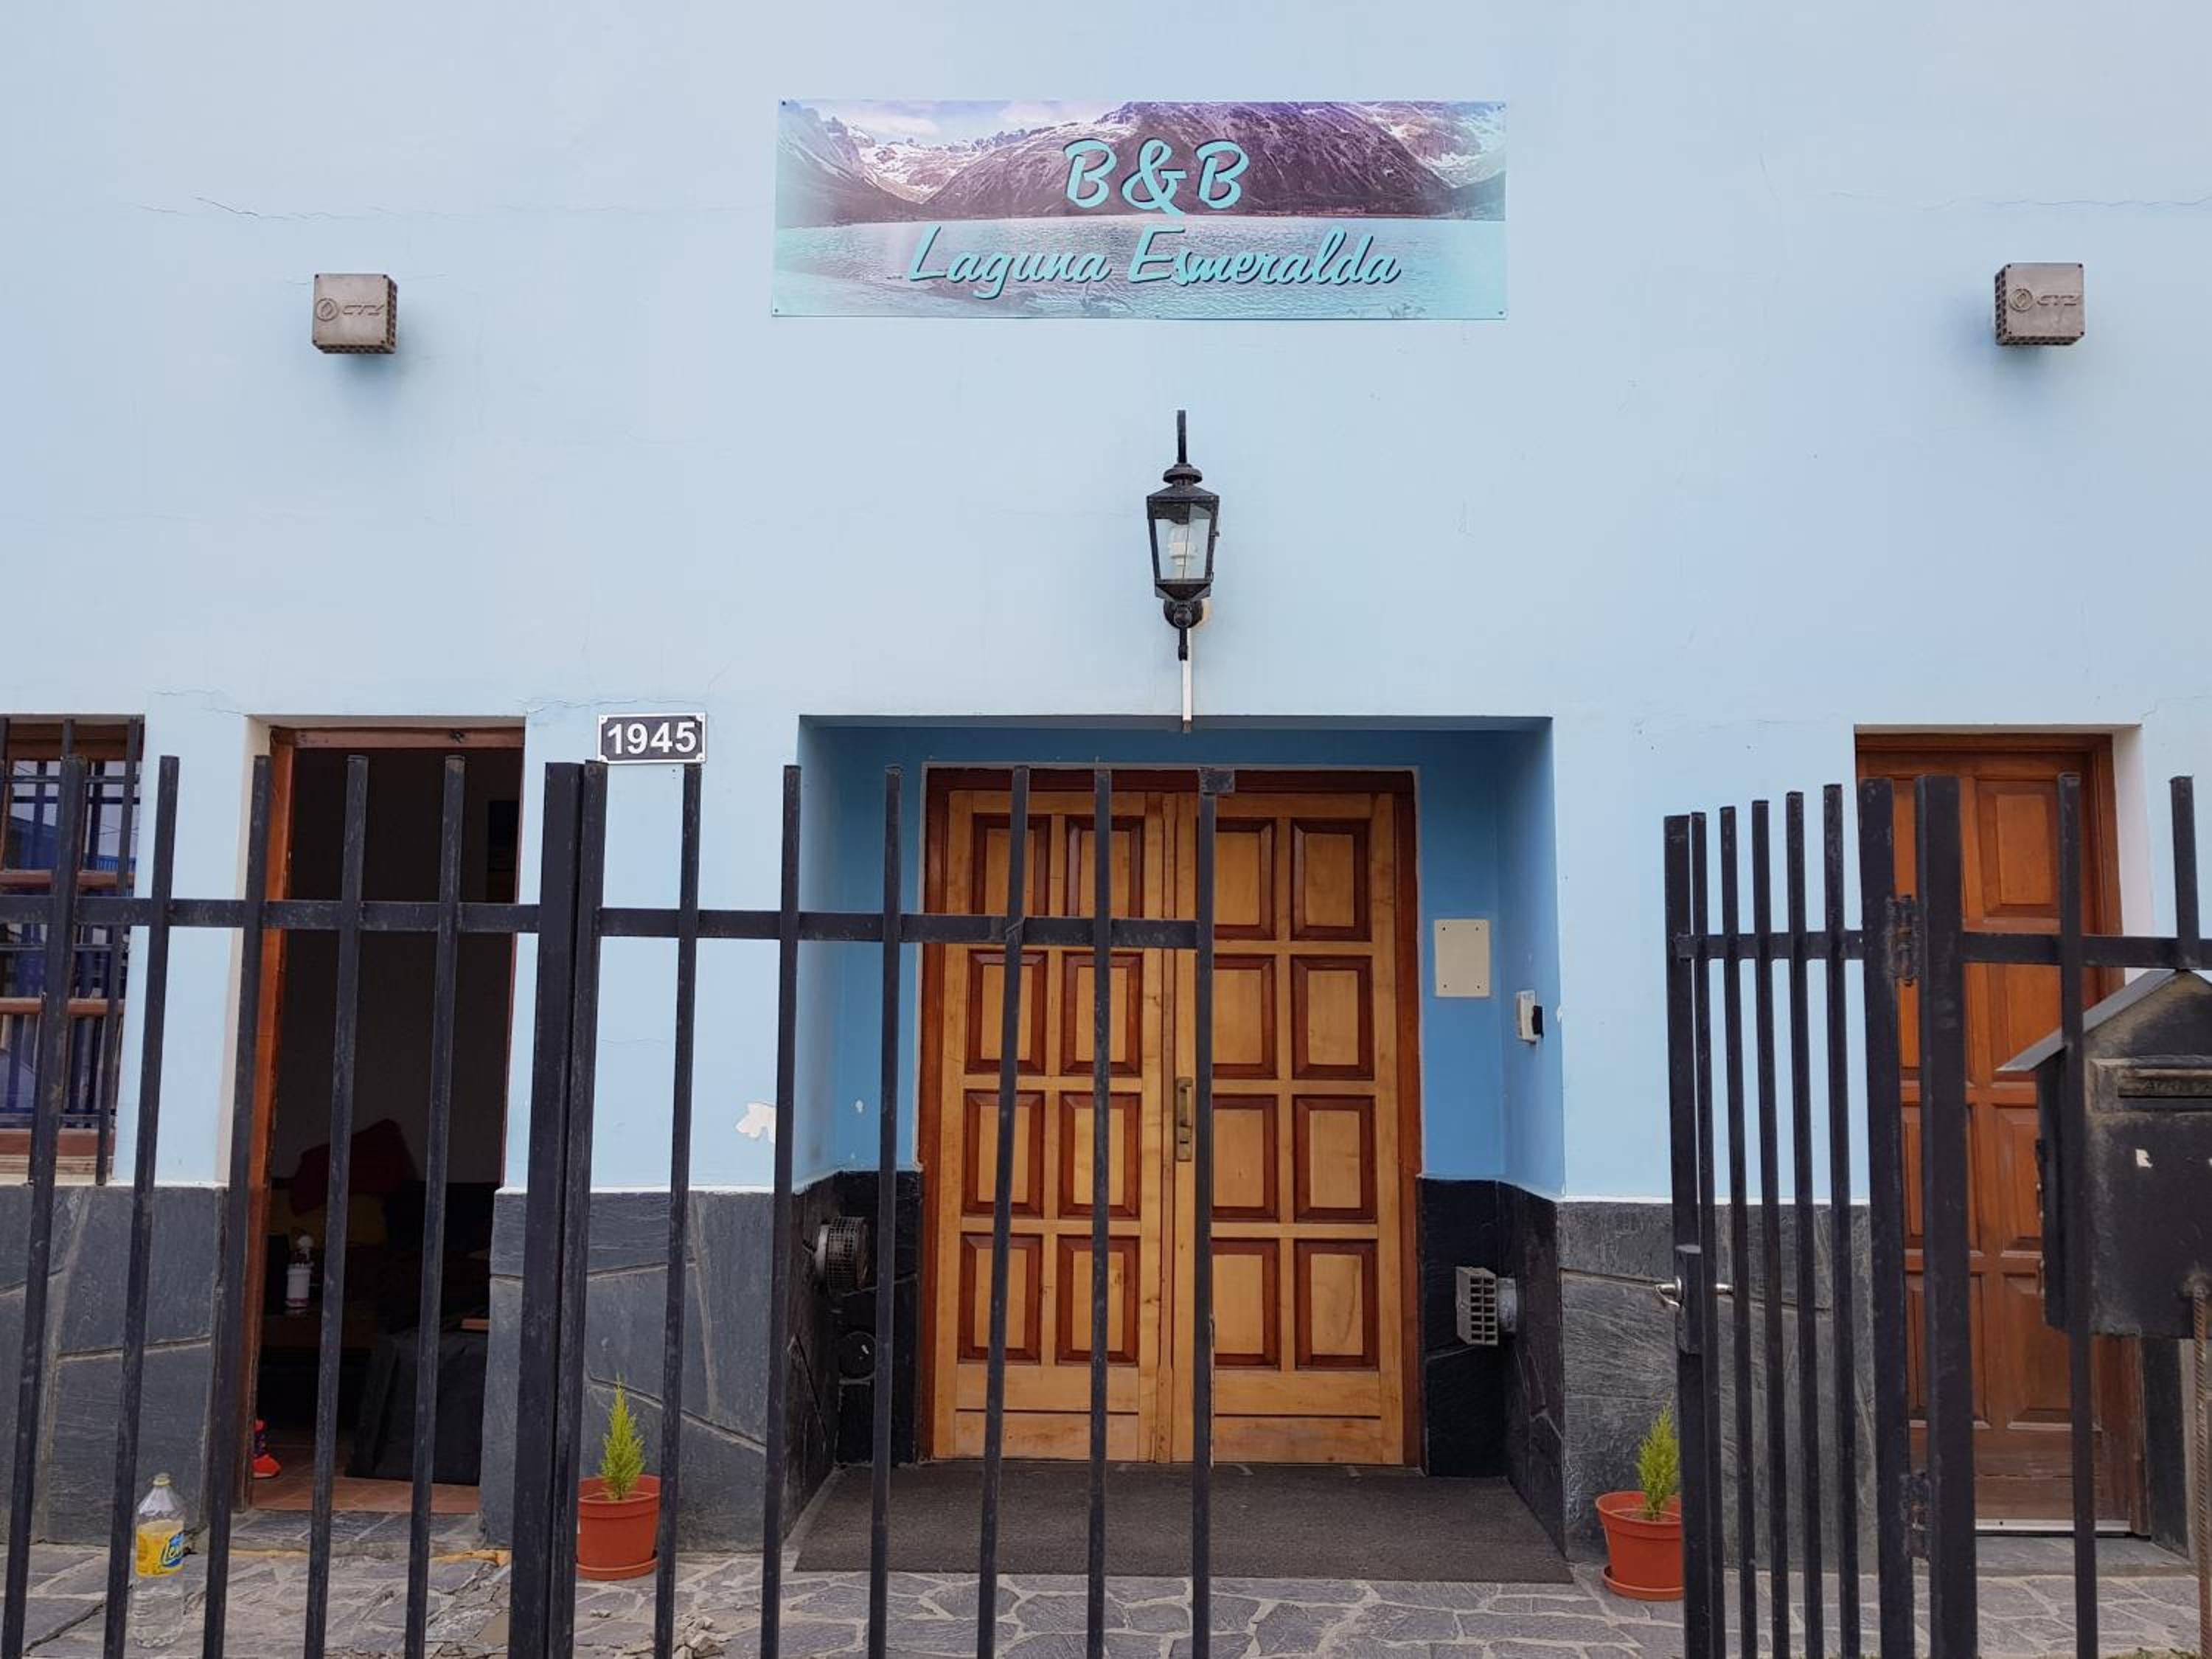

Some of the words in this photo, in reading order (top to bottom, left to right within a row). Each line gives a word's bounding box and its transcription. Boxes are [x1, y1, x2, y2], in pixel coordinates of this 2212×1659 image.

[909, 223, 1113, 300] Laguna
[1127, 223, 1402, 286] Esmeralda
[607, 721, 697, 754] 1945
